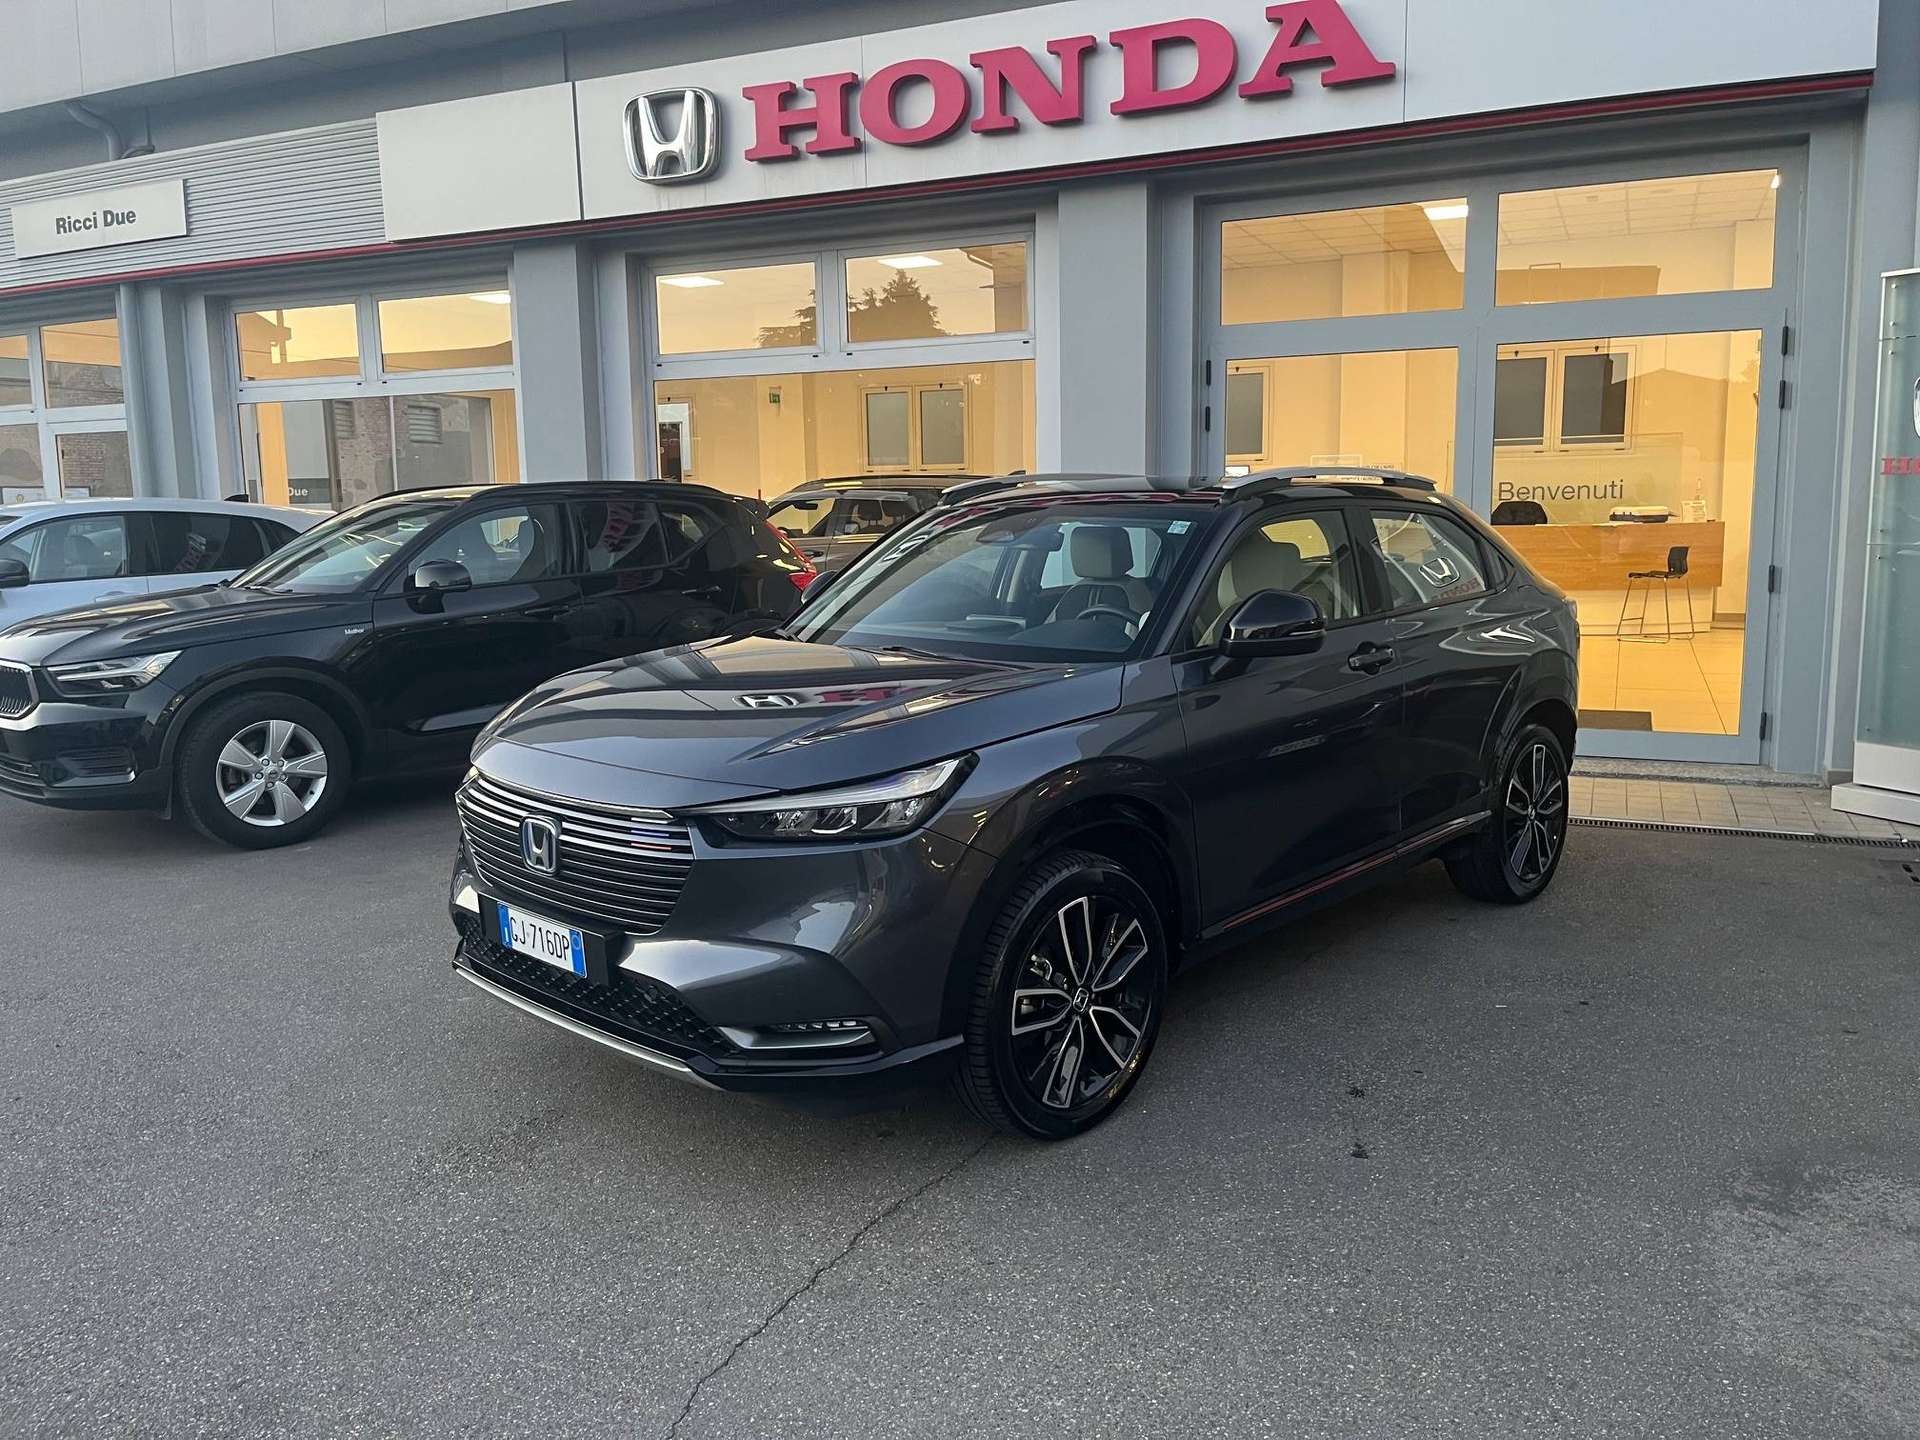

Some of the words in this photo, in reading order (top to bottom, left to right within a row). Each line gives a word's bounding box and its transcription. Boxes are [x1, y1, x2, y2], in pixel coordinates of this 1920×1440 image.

[741, 0, 1396, 162] HONDA
[55, 211, 98, 235] Ricci
[103, 209, 137, 228] Due
[1498, 479, 1624, 501] Benvenuti
